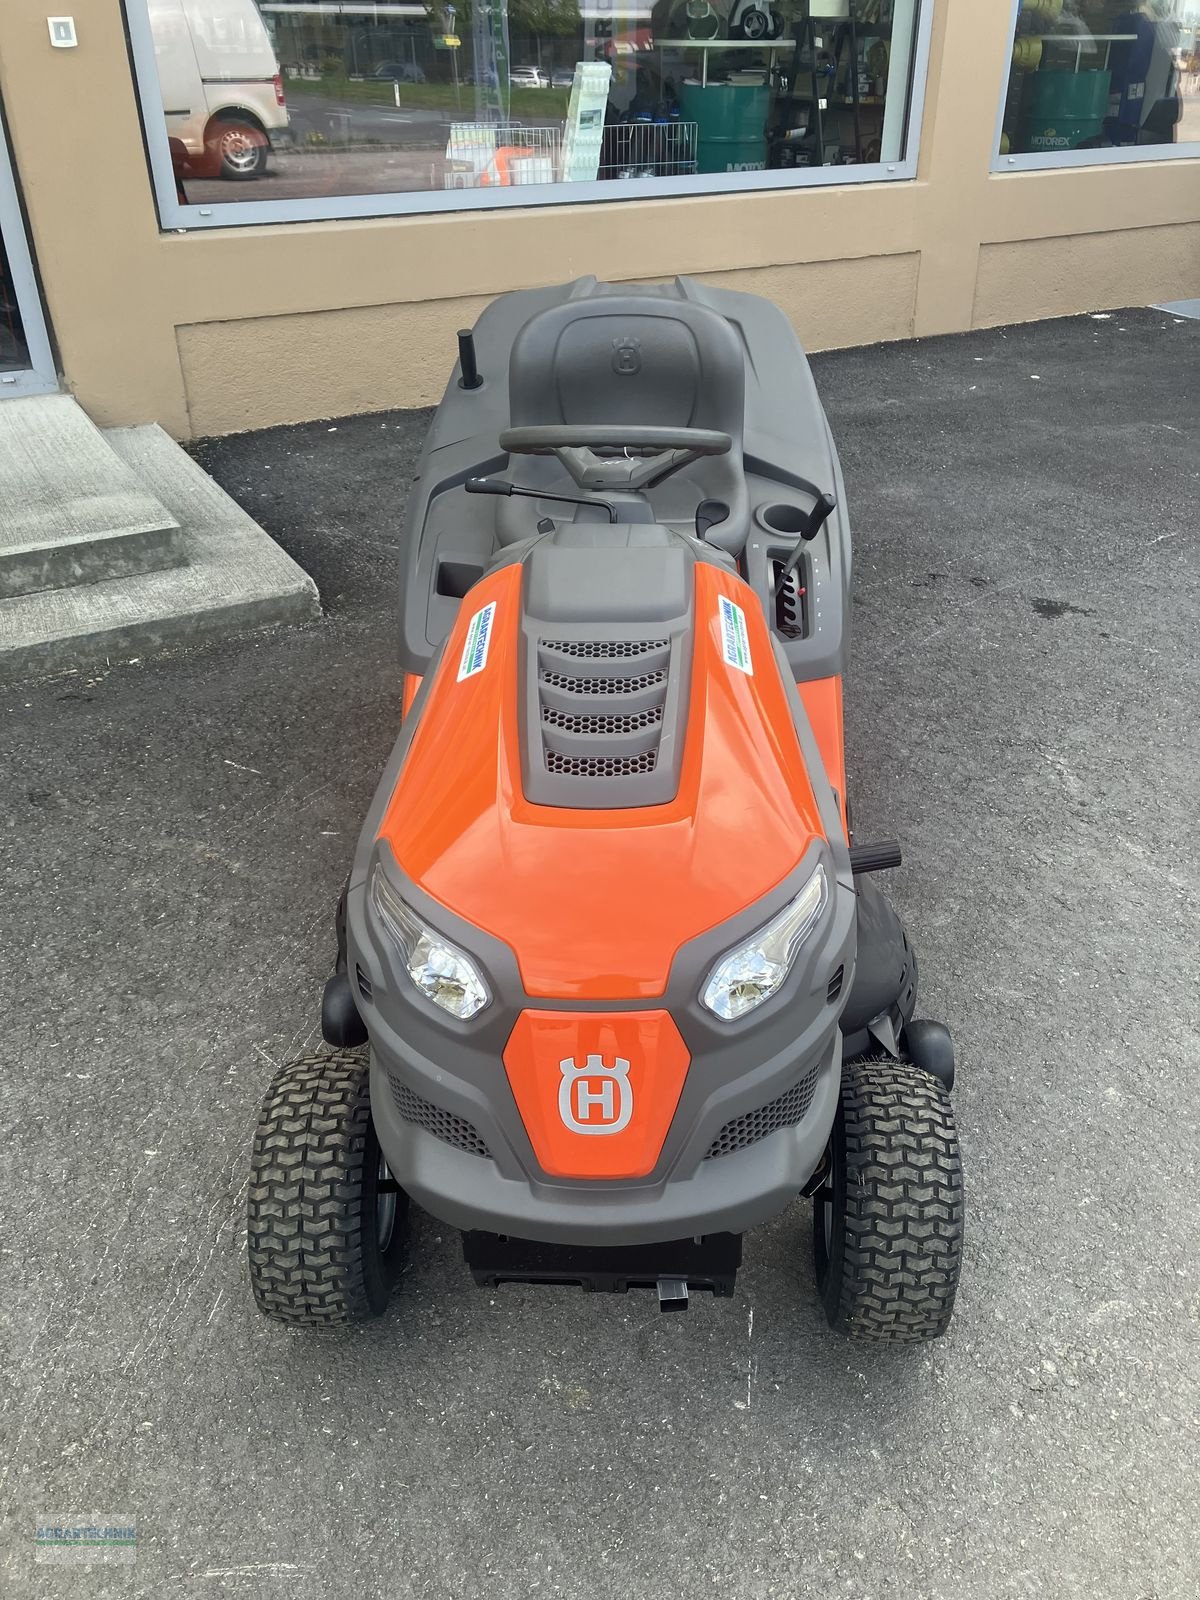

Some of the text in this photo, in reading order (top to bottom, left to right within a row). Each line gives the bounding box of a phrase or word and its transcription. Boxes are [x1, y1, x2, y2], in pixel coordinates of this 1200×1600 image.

[1031, 136, 1070, 147] MOTOREX
[472, 607, 492, 671] AGRARTECHNIK
[722, 599, 738, 664] AGRARTECHNIK
